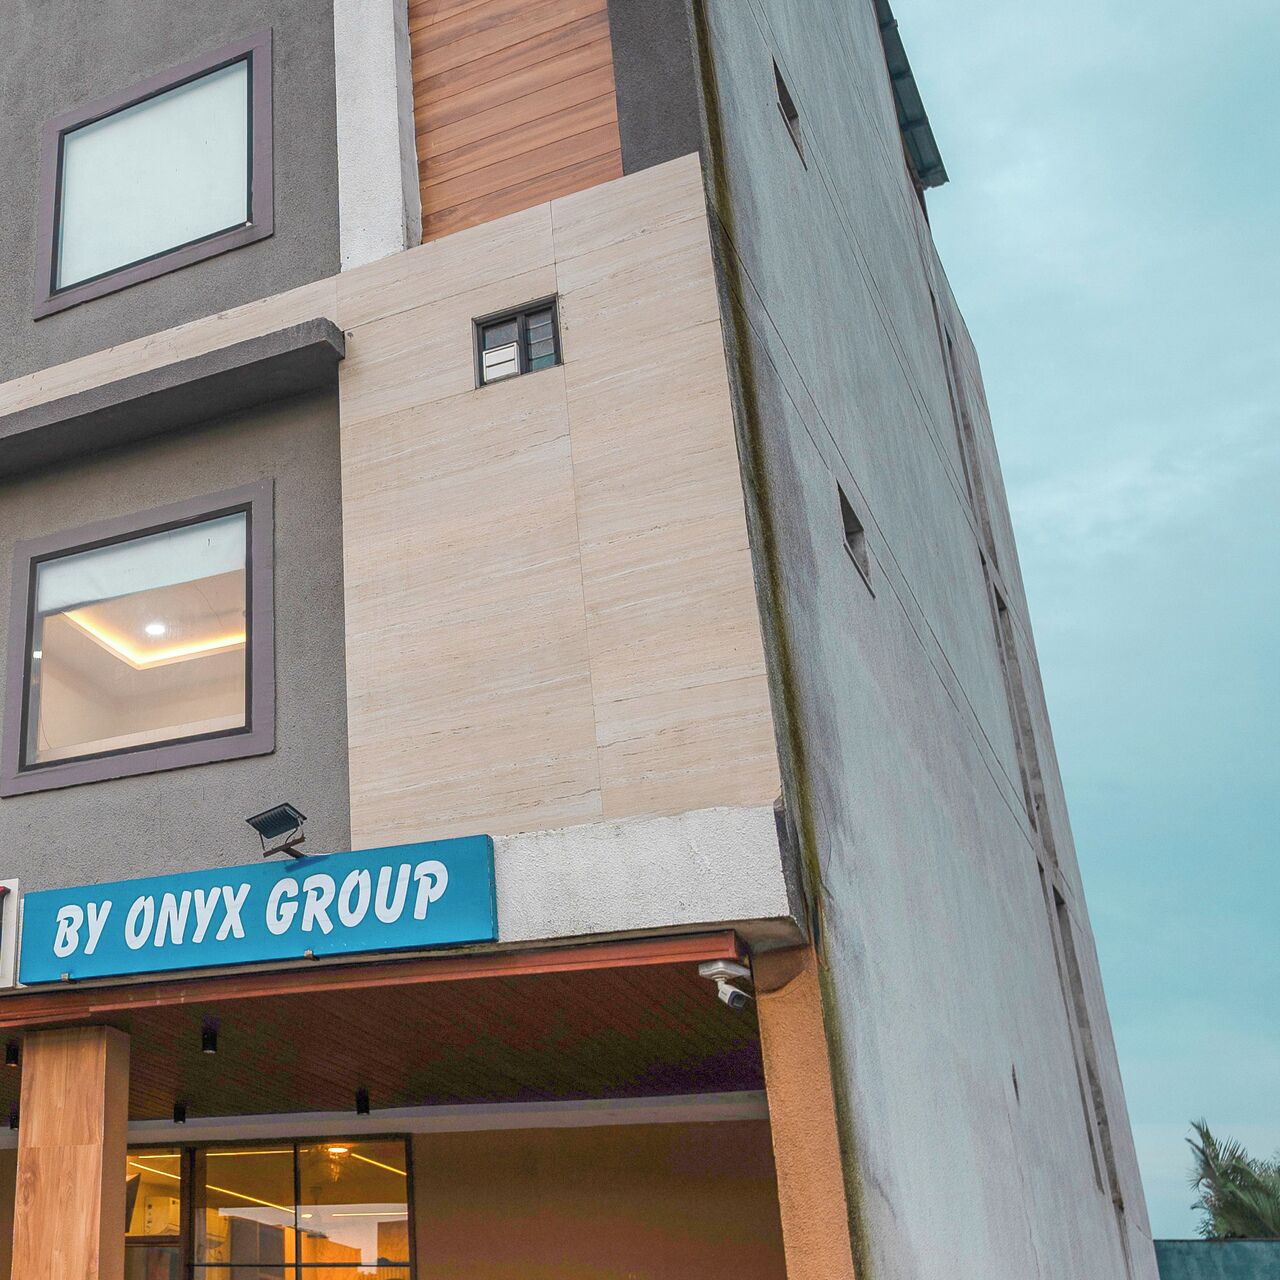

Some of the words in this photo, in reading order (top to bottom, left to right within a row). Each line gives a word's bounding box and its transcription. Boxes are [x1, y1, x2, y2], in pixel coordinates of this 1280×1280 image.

[53, 900, 112, 958] BY
[124, 883, 251, 951] ONYX
[265, 860, 448, 936] GROUP
